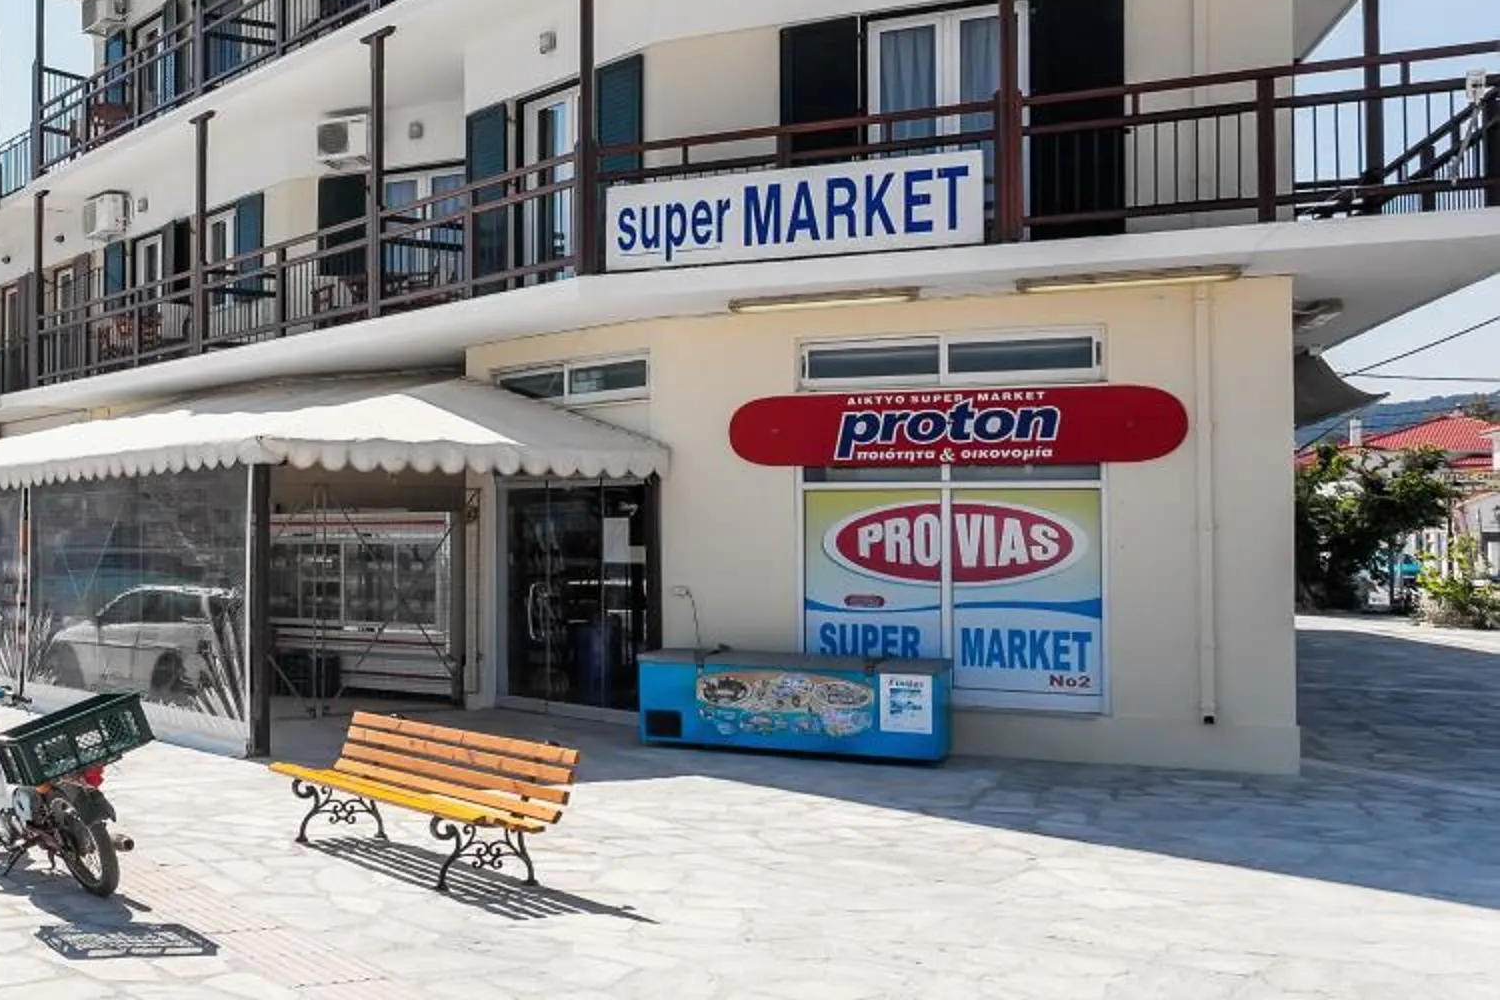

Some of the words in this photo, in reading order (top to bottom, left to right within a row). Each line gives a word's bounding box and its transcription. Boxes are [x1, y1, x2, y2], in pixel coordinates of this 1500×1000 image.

[616, 196, 731, 262] super
[743, 165, 970, 247] MARKET
[910, 393, 963, 404] SUPER
[976, 391, 1046, 402] MARKET
[834, 398, 1061, 461] proton
[856, 448, 936, 462] ποιότητα
[939, 448, 956, 462] &
[960, 447, 1053, 461] οικονομία
[857, 513, 1061, 568] PROVIAS
[819, 621, 921, 658] SUPER
[961, 627, 1093, 673] MARKET
[1050, 674, 1092, 689] No2
